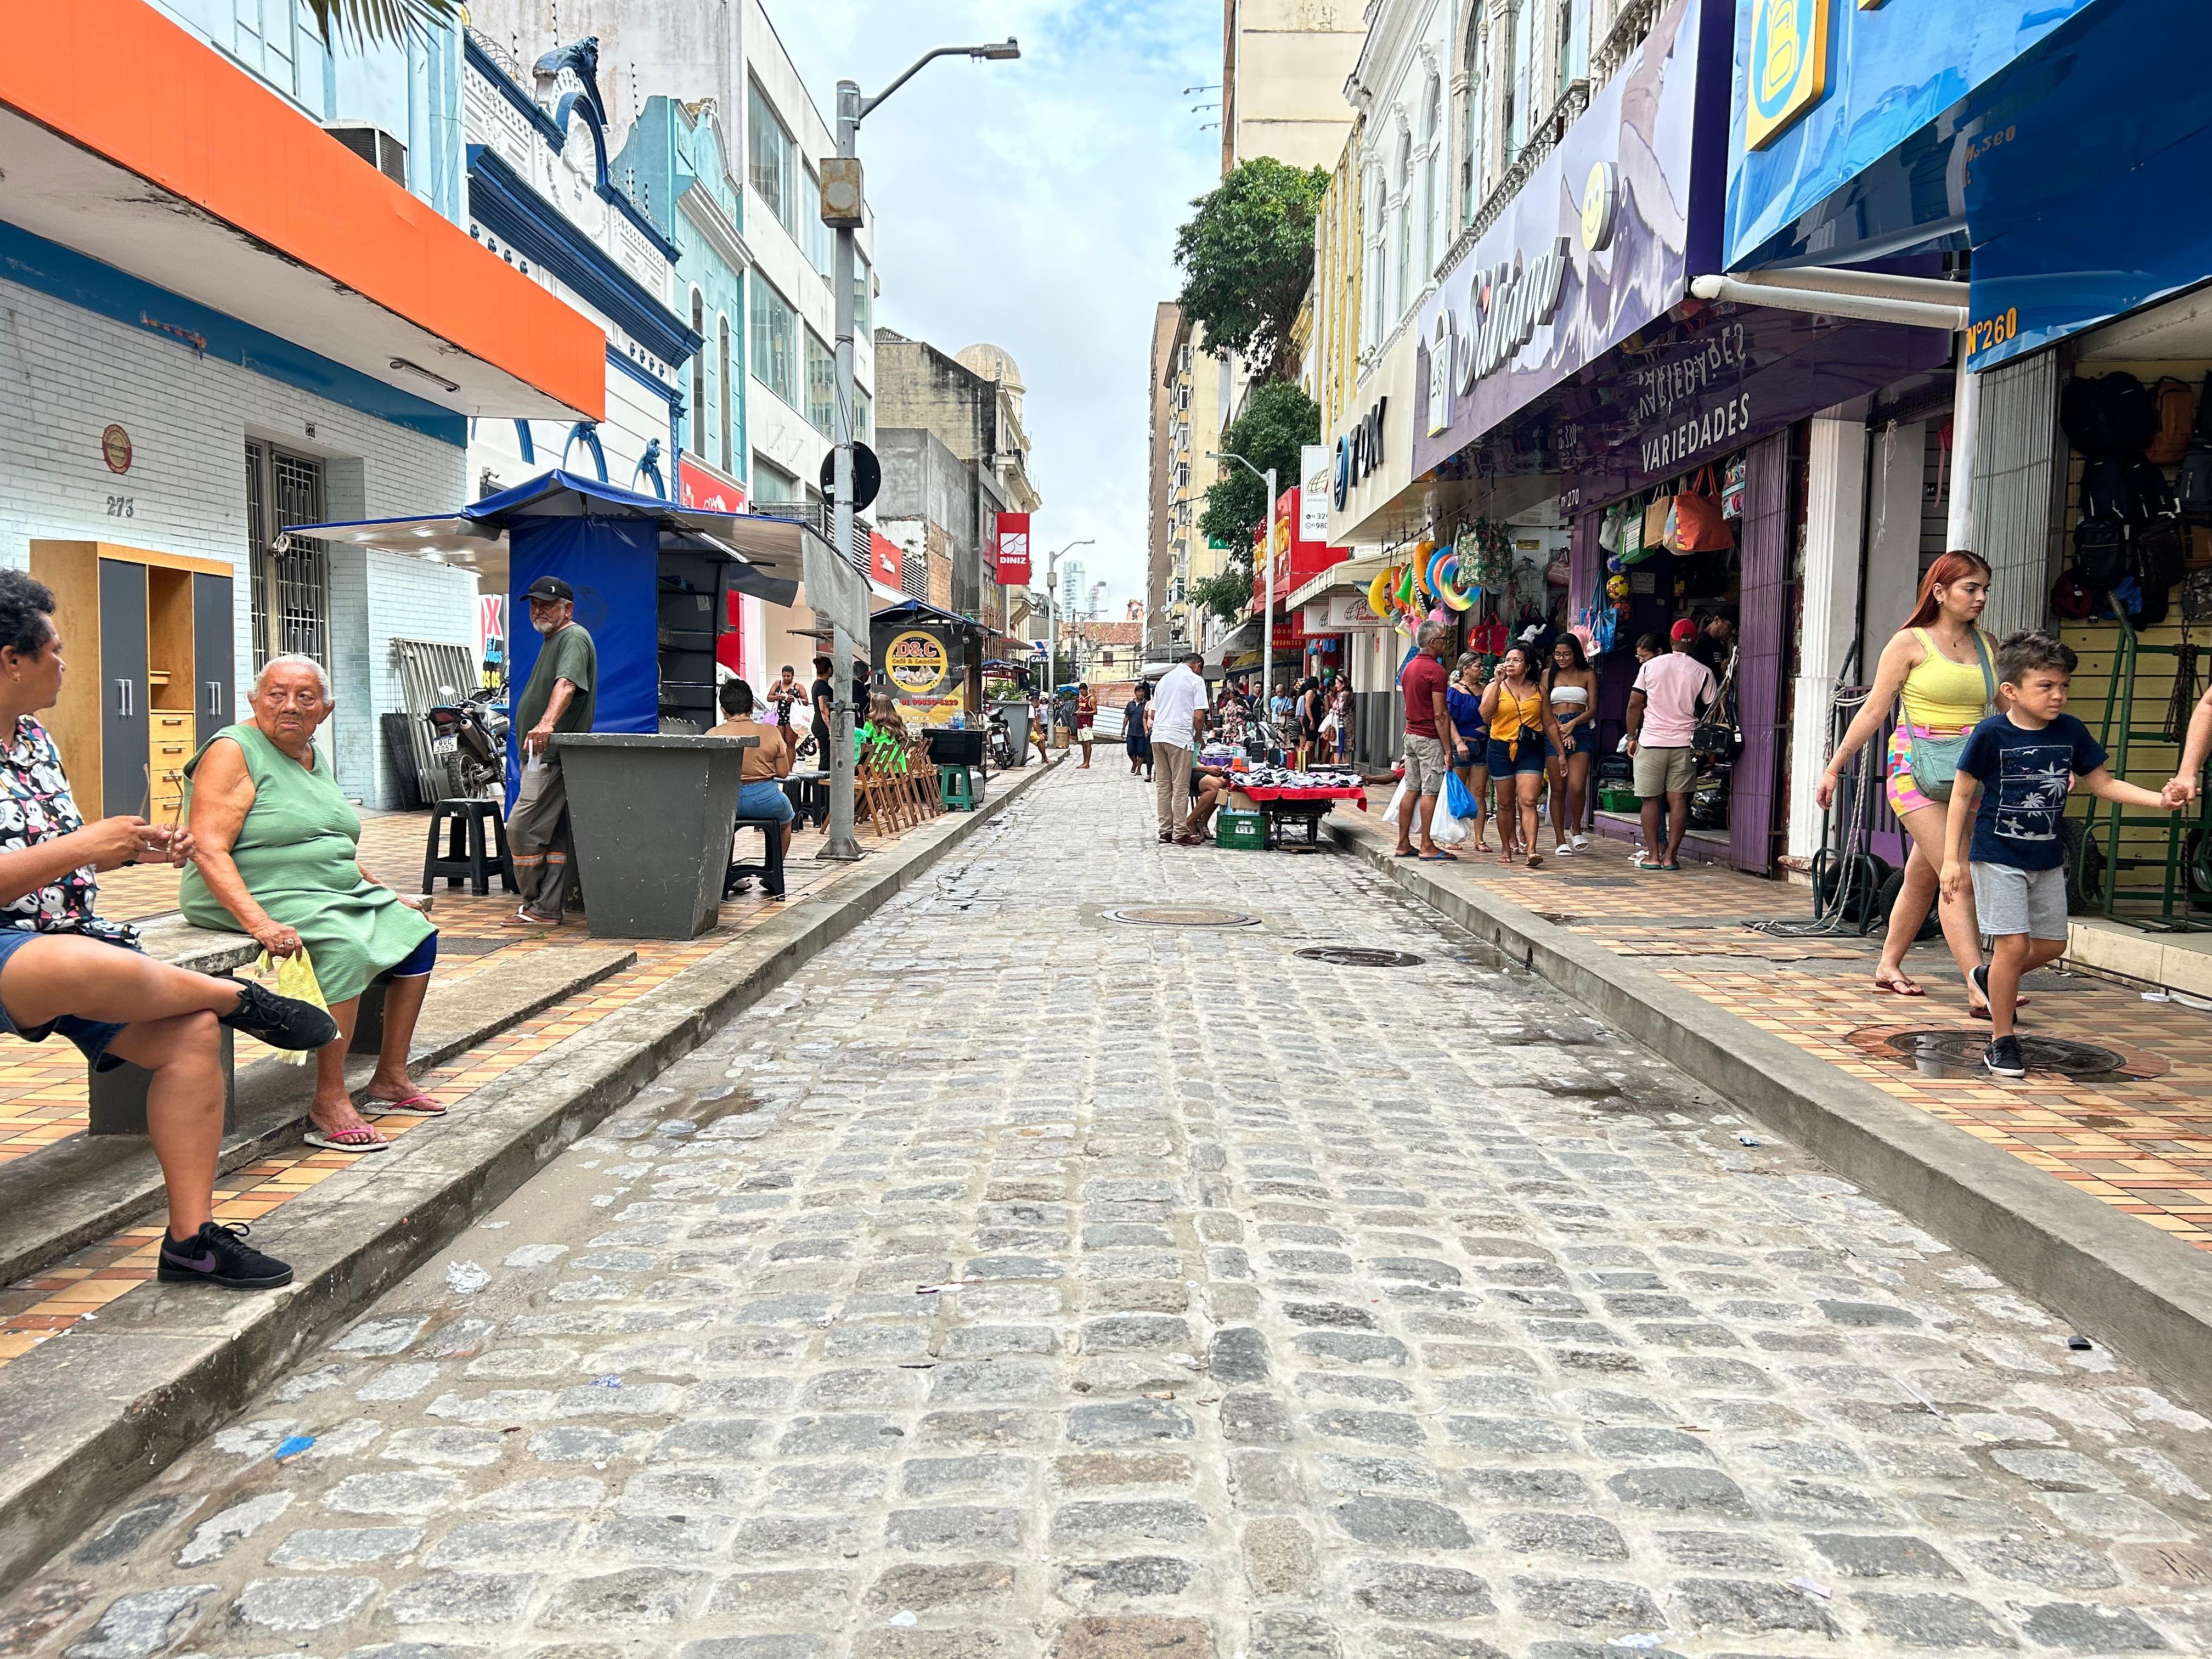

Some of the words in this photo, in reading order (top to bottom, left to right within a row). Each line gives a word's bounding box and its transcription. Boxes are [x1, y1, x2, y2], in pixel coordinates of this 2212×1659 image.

[1456, 237, 1571, 397] Silvana
[1642, 392, 1750, 473] VARIEDADES
[106, 496, 133, 517] 273
[1356, 607, 1379, 620] Paulinas
[896, 641, 937, 657] D&C
[1448, 630, 1457, 659] 274
[486, 650, 503, 663] JUROS
